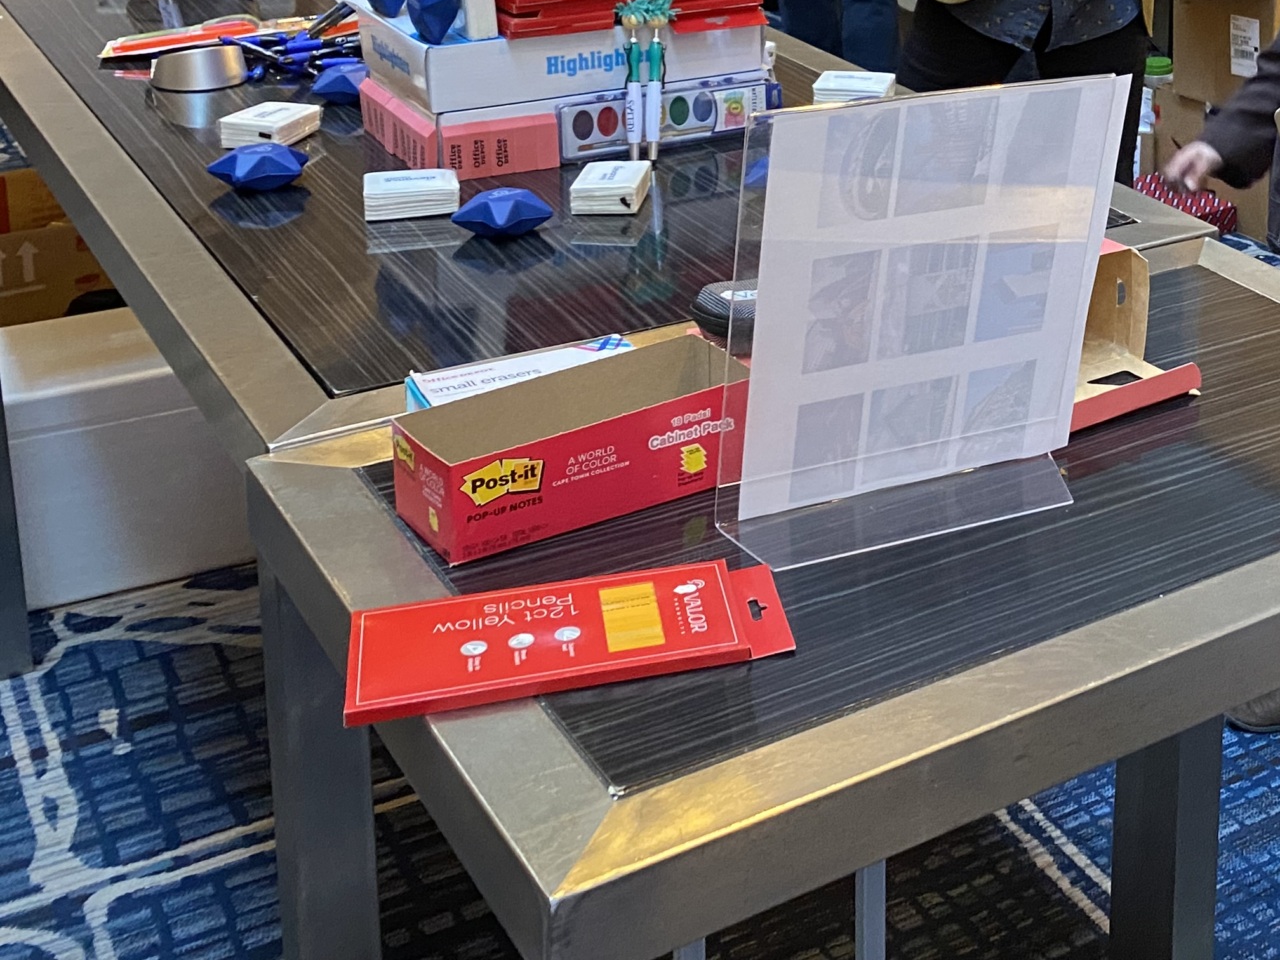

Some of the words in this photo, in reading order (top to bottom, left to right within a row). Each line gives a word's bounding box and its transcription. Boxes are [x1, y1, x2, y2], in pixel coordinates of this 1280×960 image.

[496, 138, 504, 167] Office
[430, 379, 477, 394] small
[481, 368, 542, 385] erasers
[648, 424, 701, 450] Cabinet
[701, 417, 735, 436] Pack
[566, 464, 580, 475] OF
[582, 454, 617, 471] COLOR
[568, 456, 576, 466] A
[577, 445, 615, 462] WORLD
[471, 463, 538, 495] Post-it
[552, 477, 569, 487] CAPE
[590, 460, 630, 476] COLLECTION
[467, 504, 507, 524] POP-UP
[509, 495, 543, 513] NOTES
[483, 592, 574, 615] Pencils
[523, 603, 580, 622] 12ct
[684, 592, 708, 634] VALOR
[433, 613, 516, 634] Yellow
